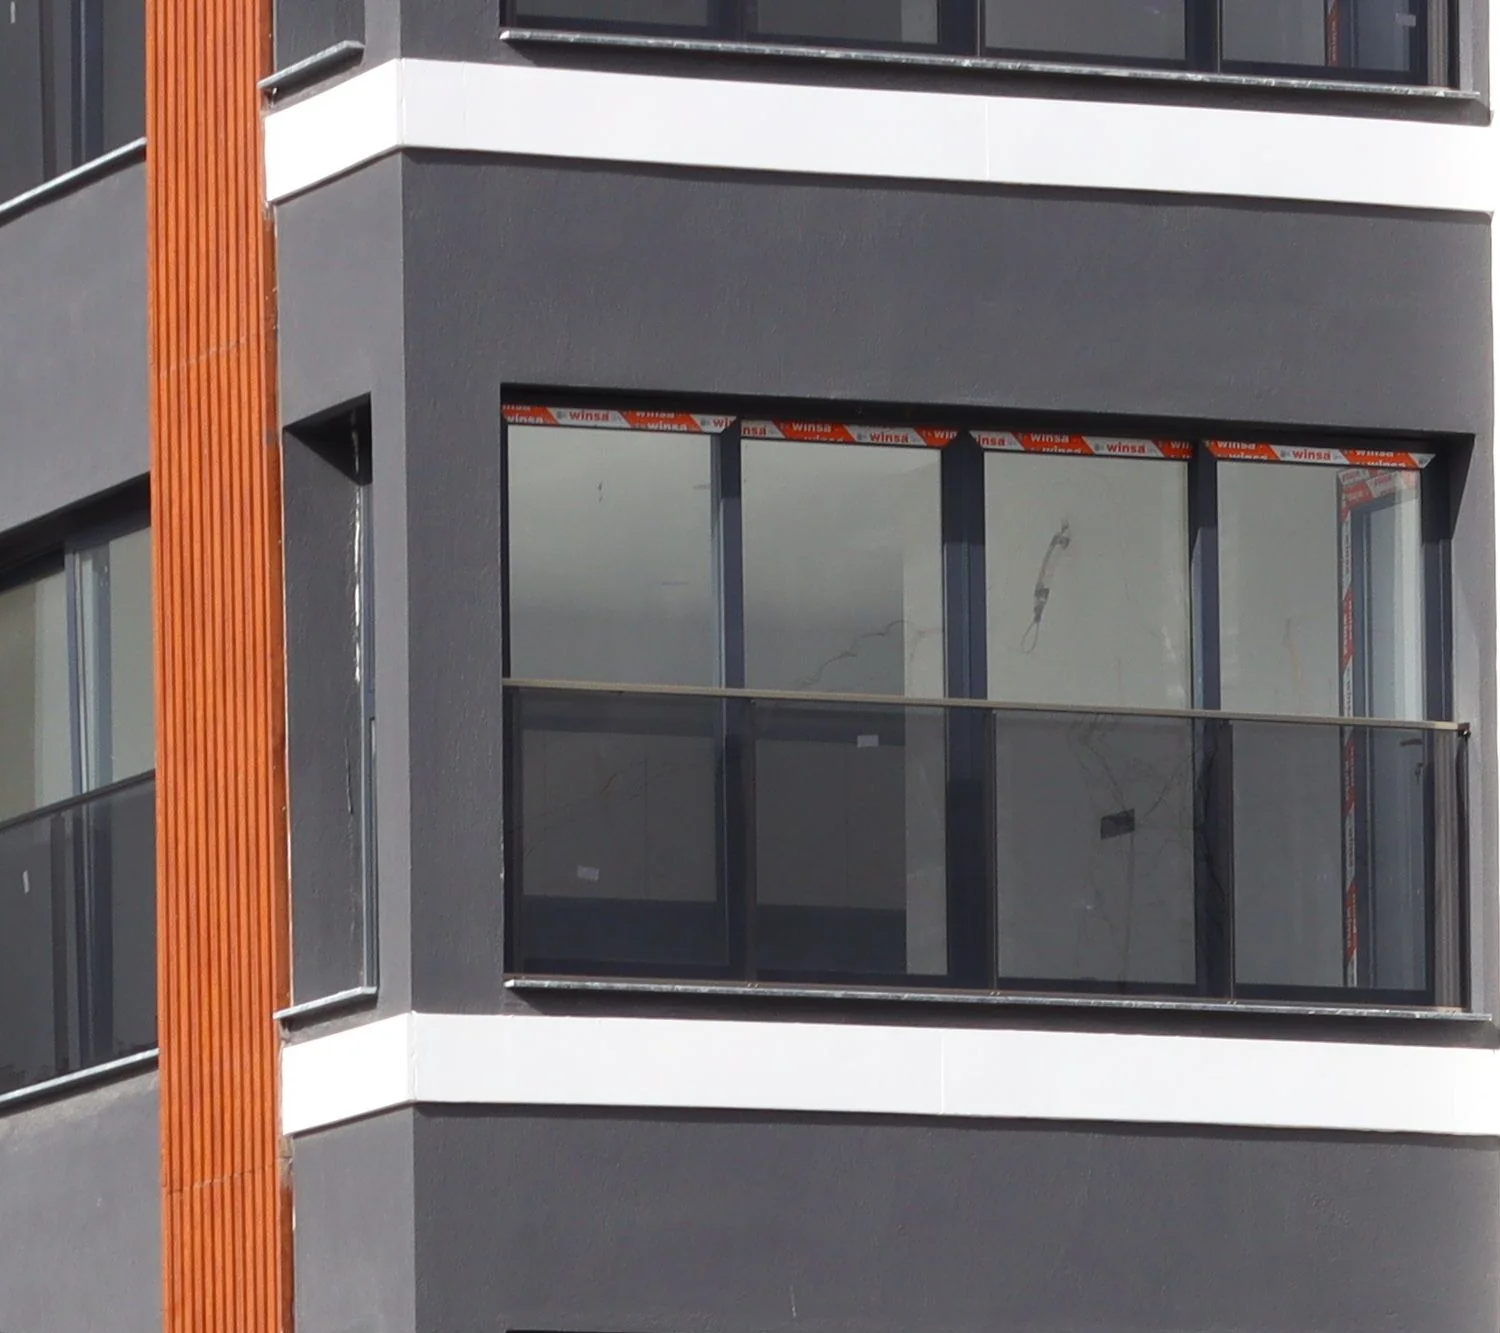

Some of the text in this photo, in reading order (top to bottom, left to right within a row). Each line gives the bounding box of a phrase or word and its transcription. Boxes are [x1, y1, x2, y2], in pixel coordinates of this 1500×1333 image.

[569, 410, 609, 422] winsa
[792, 422, 832, 433] winsa
[869, 433, 909, 444] winsa
[1030, 433, 1070, 443] winsa
[1106, 442, 1146, 453] winsa
[1292, 449, 1331, 461] winsa
